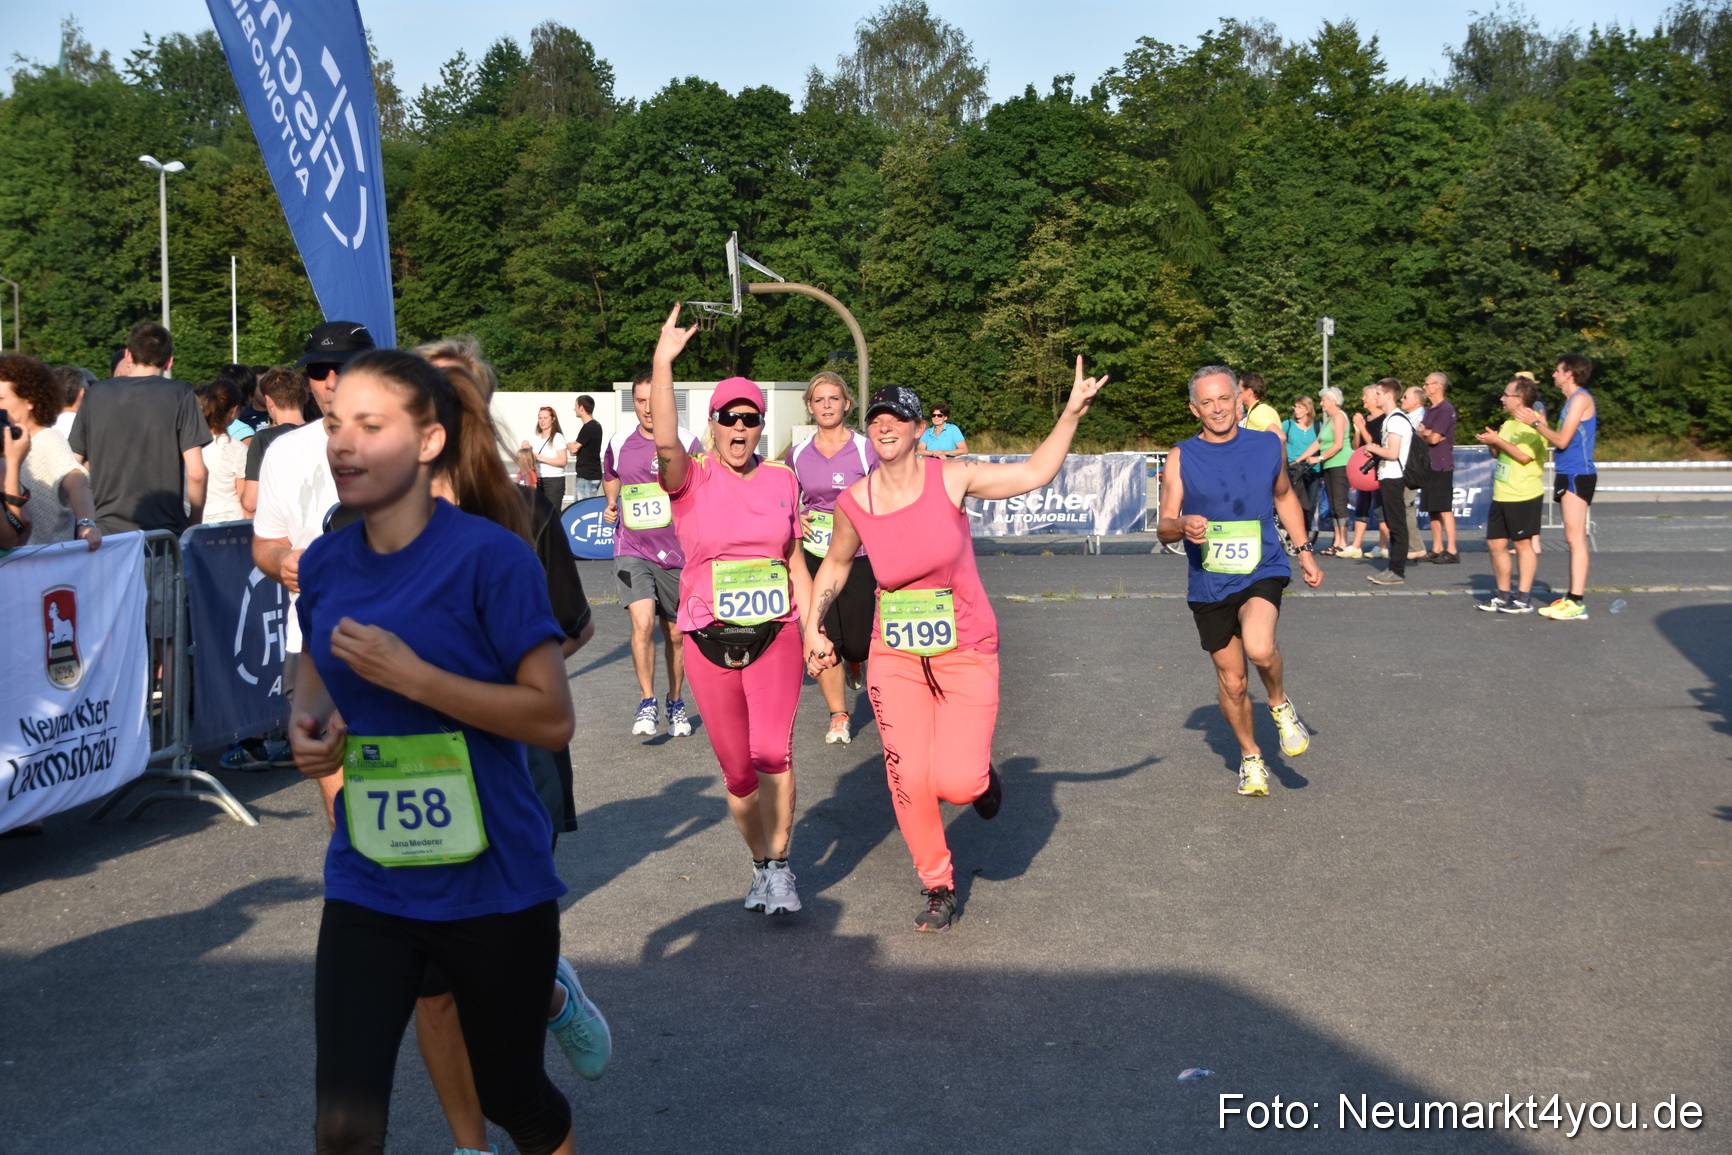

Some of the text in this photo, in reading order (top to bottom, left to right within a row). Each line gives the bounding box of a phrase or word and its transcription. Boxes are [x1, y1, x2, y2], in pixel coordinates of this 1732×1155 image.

[632, 501, 662, 517] 513
[993, 513, 1088, 523] AUTOMOBILE
[586, 524, 616, 538] Fis
[814, 530, 832, 546] 51
[1212, 543, 1249, 559] 755
[719, 589, 784, 618] 5200
[886, 620, 952, 648] 5199
[54, 664, 75, 681] 1628
[367, 787, 452, 831] 758
[390, 838, 443, 848] Jana Mederer
